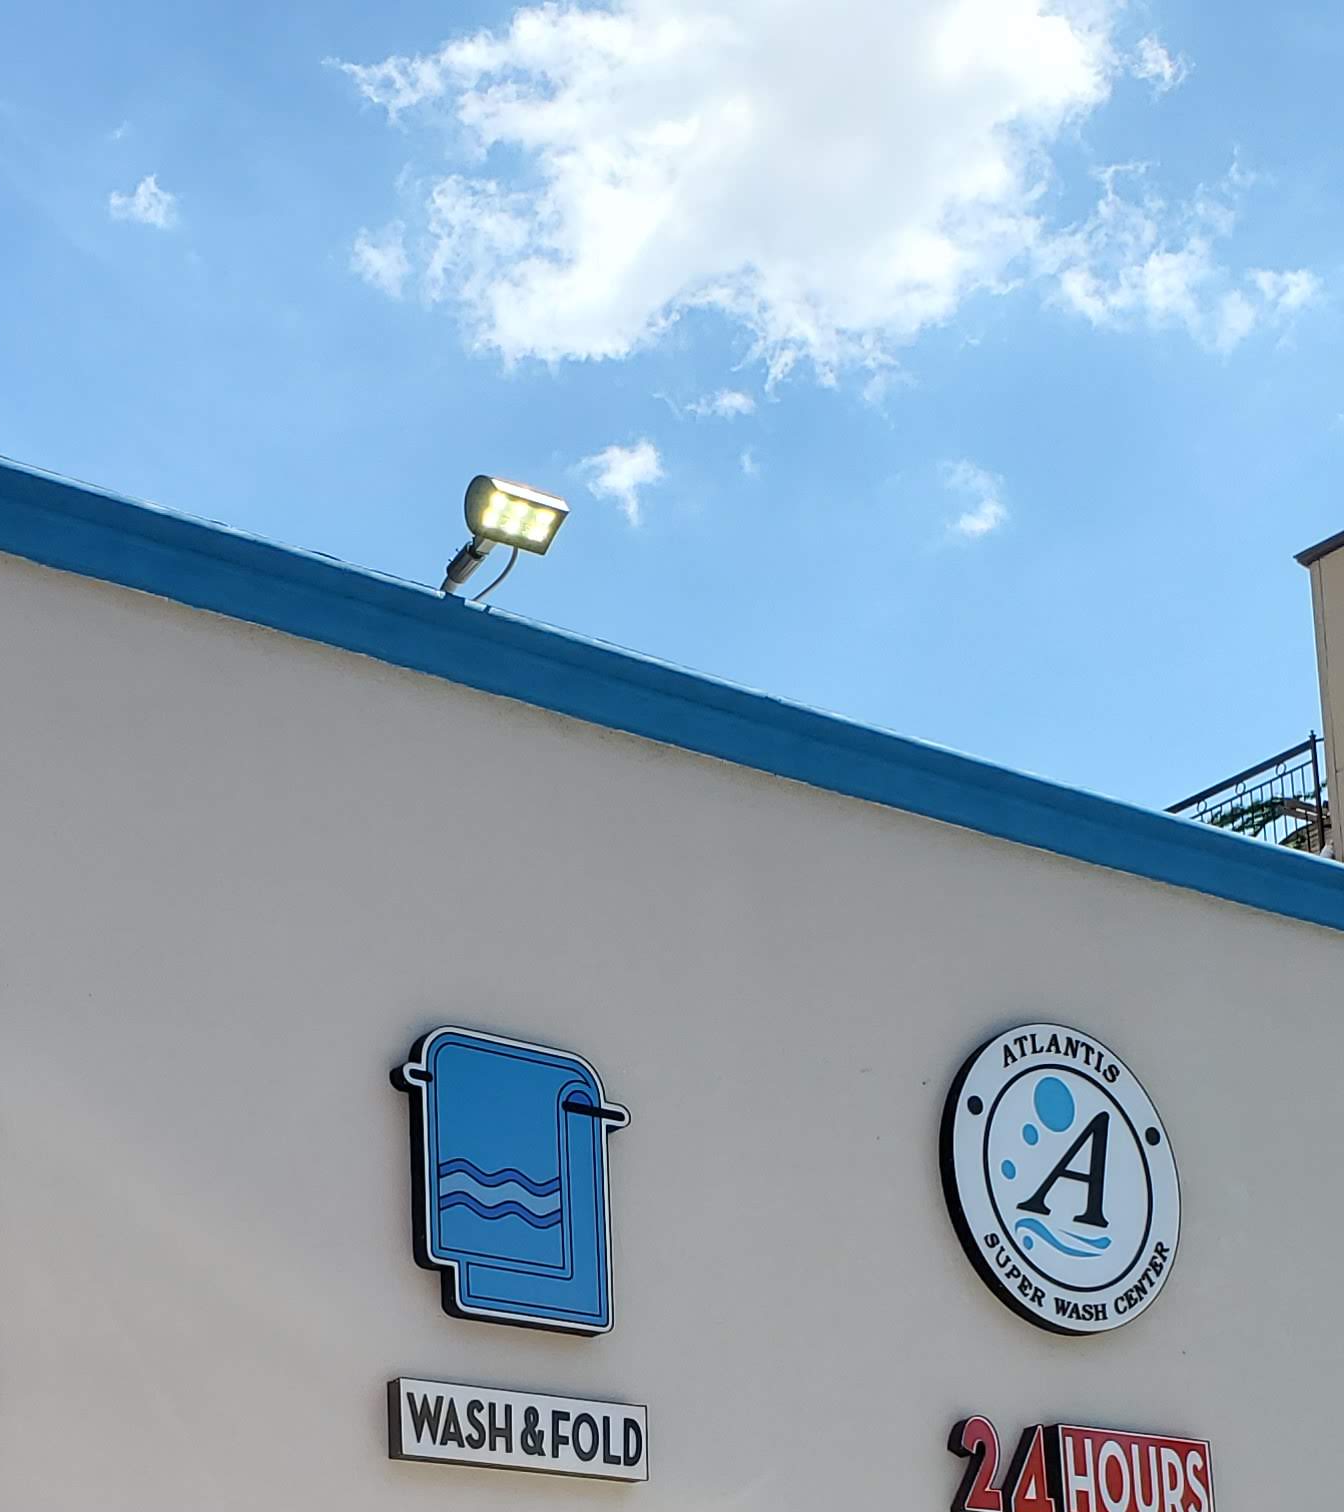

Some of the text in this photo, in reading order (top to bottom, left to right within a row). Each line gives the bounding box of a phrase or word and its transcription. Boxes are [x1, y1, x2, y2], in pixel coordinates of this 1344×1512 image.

[1002, 1033, 1121, 1083] ATLANTIS
[1016, 1111, 1109, 1228] A
[984, 1232, 1170, 1321] SUPER WASH CENTER
